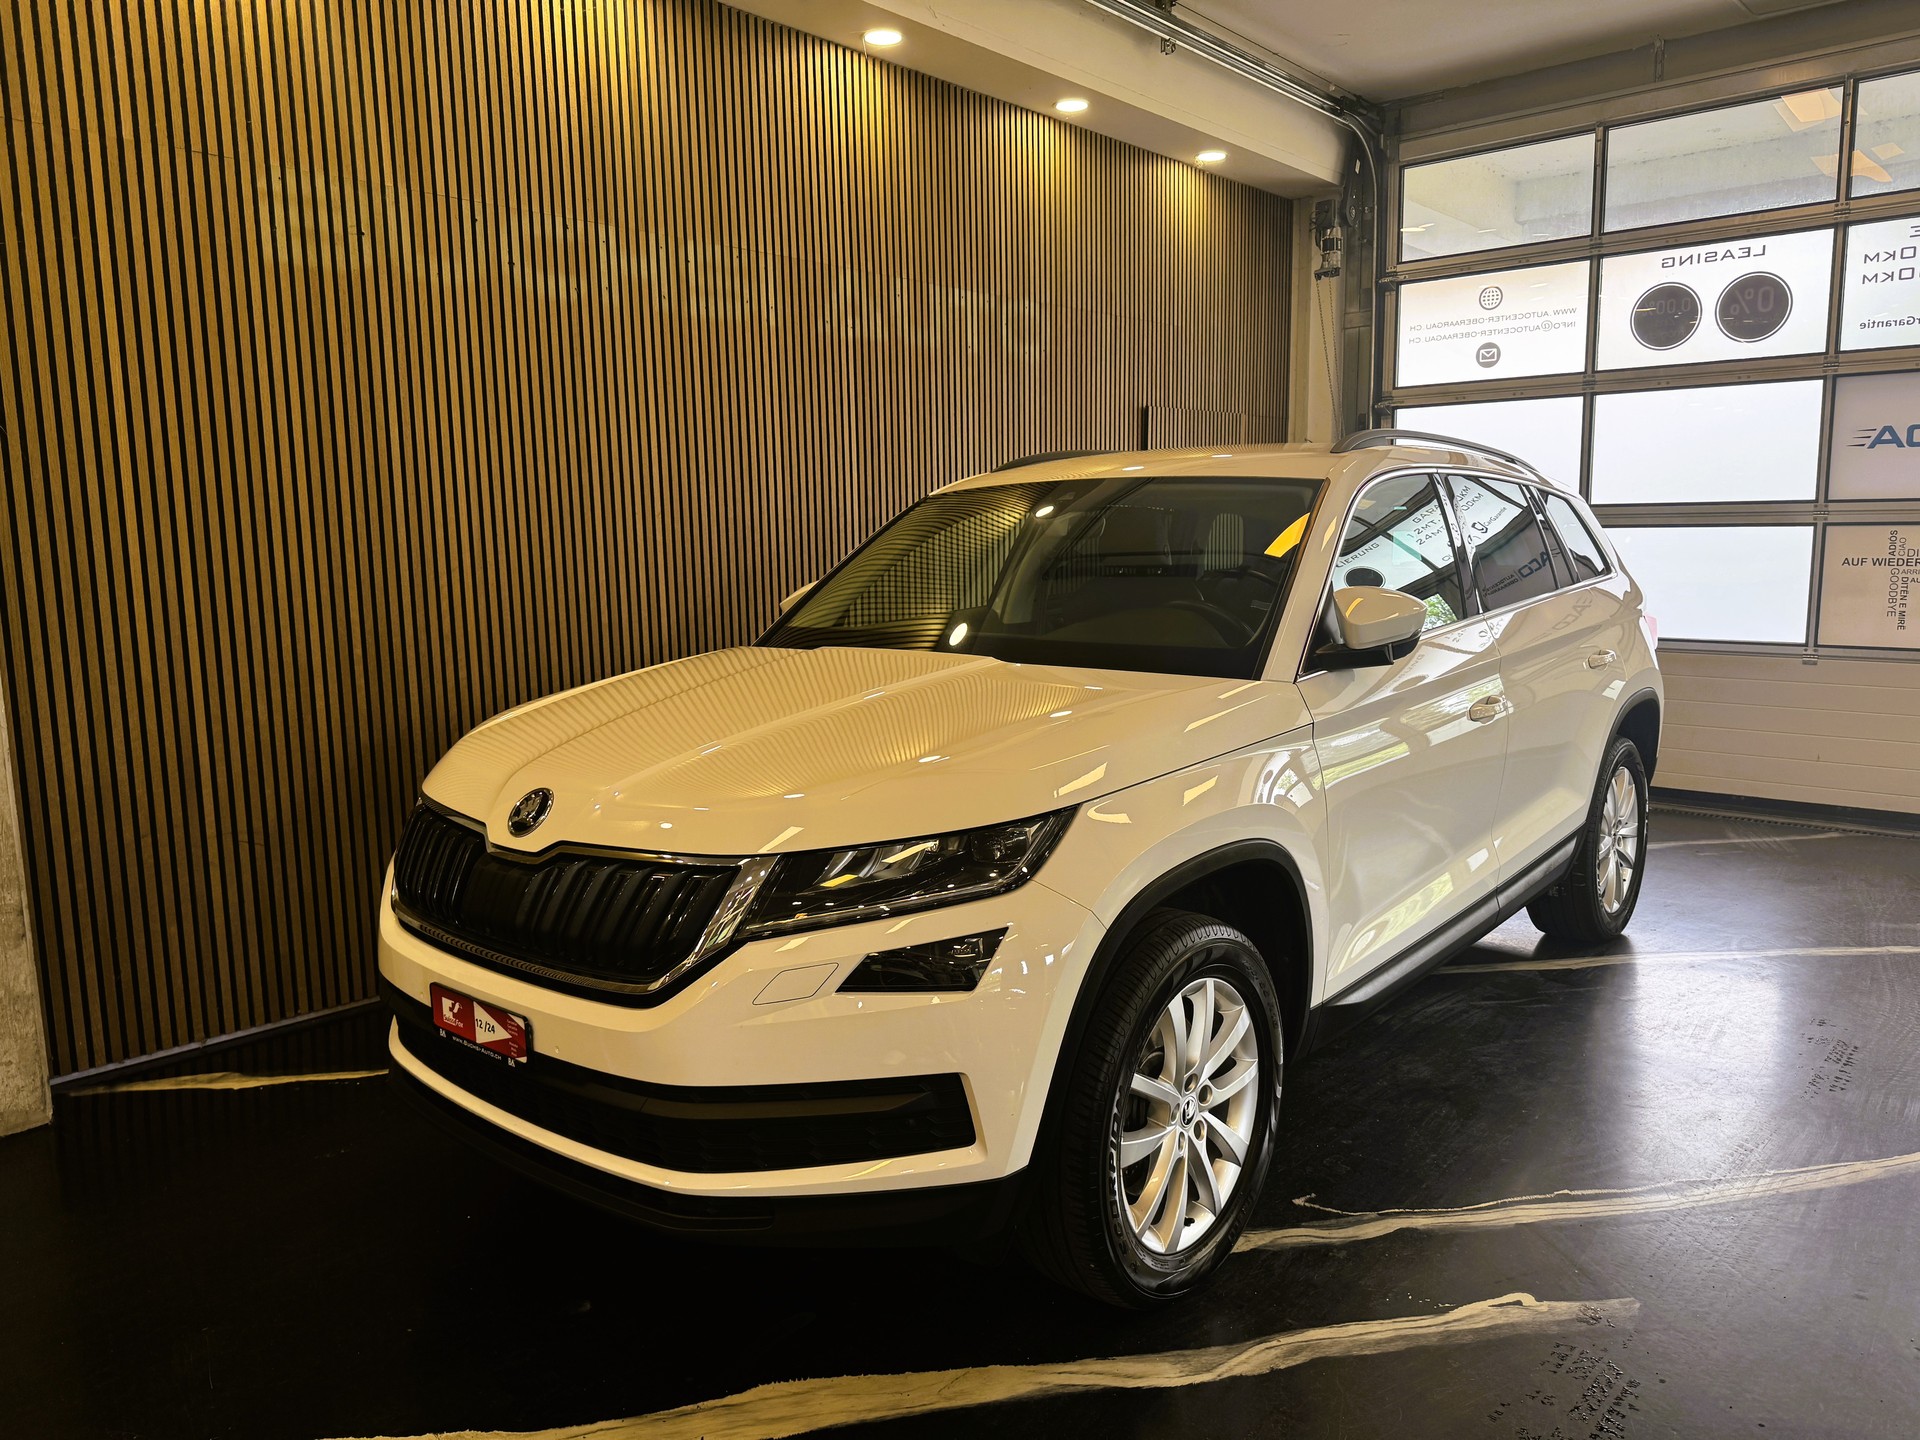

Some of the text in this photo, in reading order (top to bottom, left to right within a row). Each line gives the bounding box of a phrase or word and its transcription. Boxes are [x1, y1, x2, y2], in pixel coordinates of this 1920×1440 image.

[1898, 537, 1907, 556] CIAO
[1841, 557, 1868, 567] AUF
[1886, 567, 1900, 618] GOODBYE
